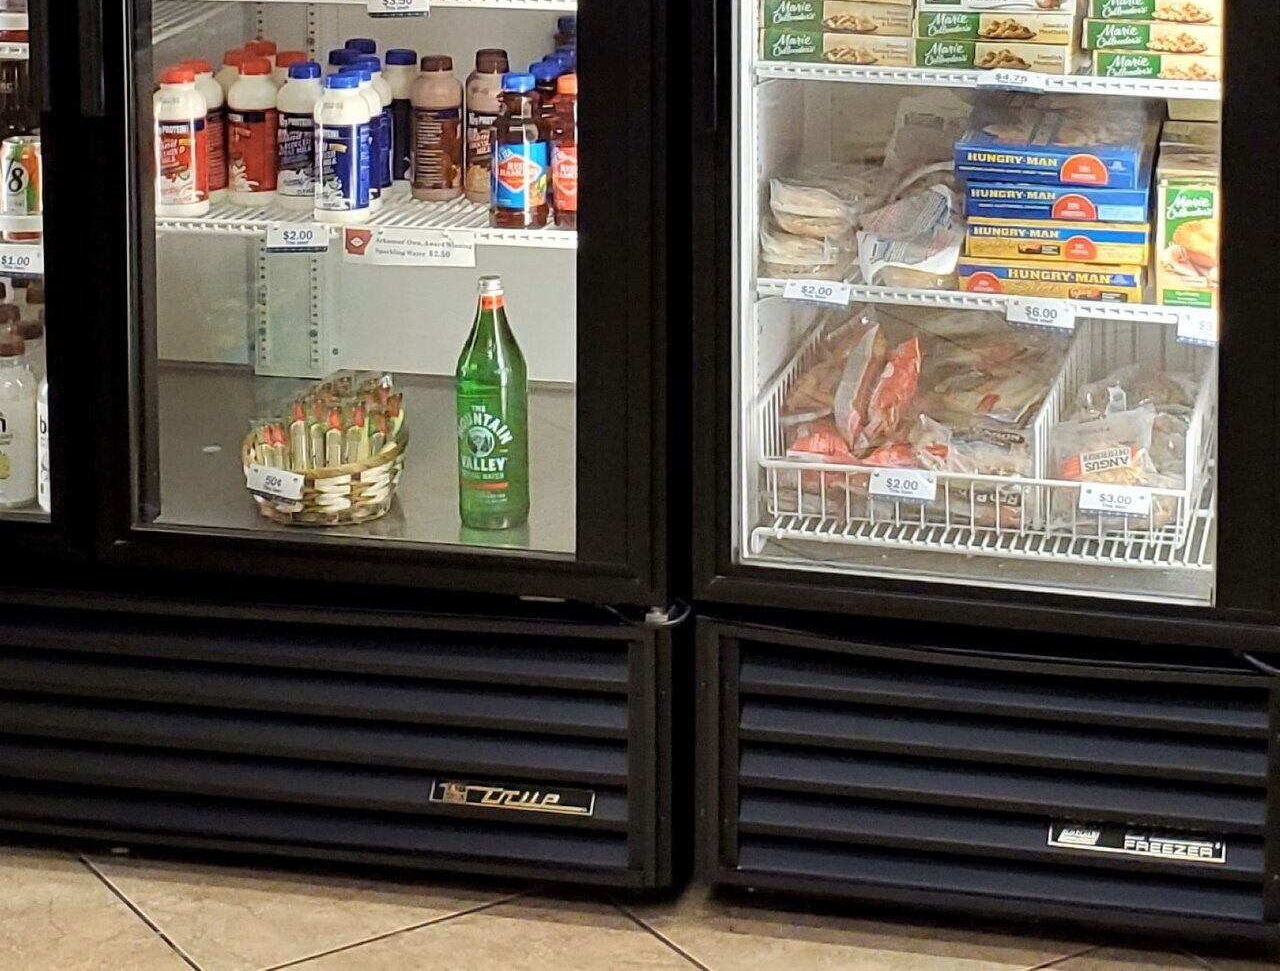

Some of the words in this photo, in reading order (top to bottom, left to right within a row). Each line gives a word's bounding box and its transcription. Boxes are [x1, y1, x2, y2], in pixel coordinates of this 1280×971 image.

[775, 0, 813, 15] Marie
[930, 13, 969, 26] Marie
[1099, 23, 1139, 39] Marie
[775, 33, 812, 48] Marie
[927, 41, 966, 56] Marie
[1108, 54, 1150, 69] Marie
[995, 73, 1028, 83] $4.75
[1169, 193, 1210, 212] Marie
[283, 229, 313, 241] $2.00
[0, 255, 30, 266] $1.00
[428, 250, 451, 259] $2.50
[800, 284, 833, 297] $2.00
[1024, 306, 1058, 320] $6.00
[461, 456, 506, 471] VALLEY
[1084, 456, 1130, 472] ANGUS
[885, 477, 918, 492] $2.00
[1099, 492, 1132, 506] $3.00
[1123, 839, 1214, 857] FREEZER
